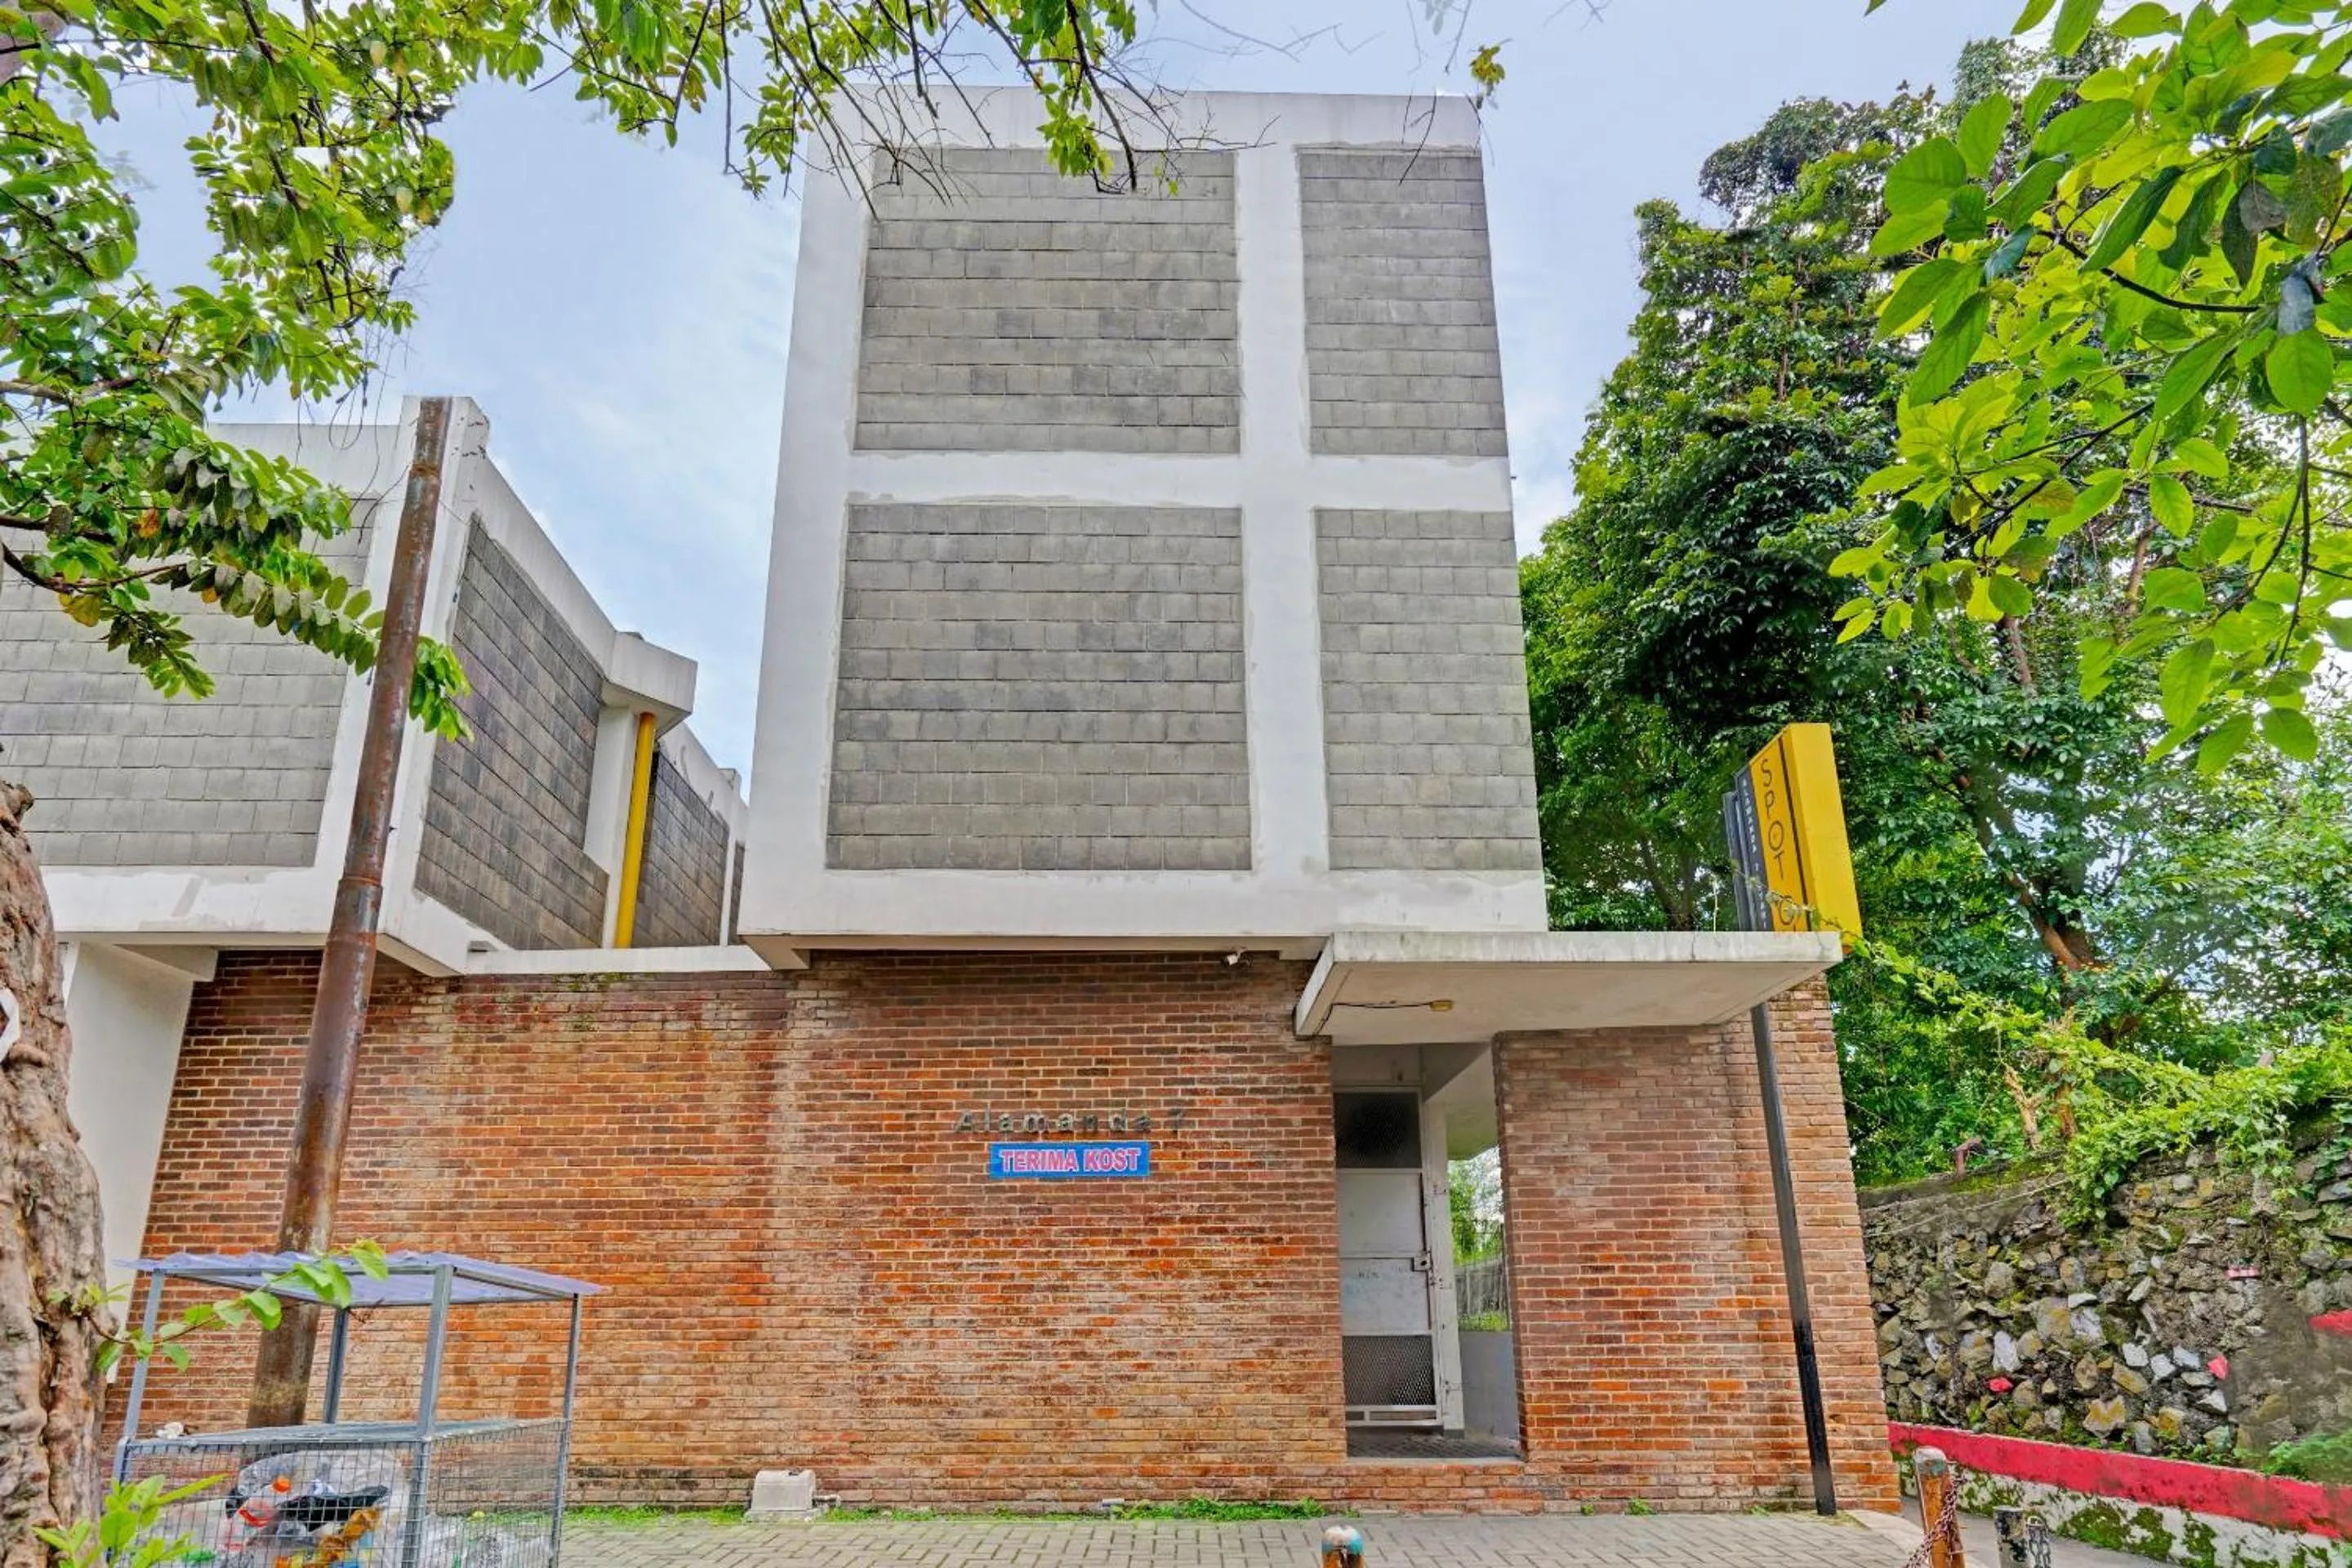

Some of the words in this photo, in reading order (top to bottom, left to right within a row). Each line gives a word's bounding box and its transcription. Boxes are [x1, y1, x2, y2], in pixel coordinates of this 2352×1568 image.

[1761, 758, 1784, 880] SPOT
[953, 1107, 1152, 1134] Alamanda
[999, 1148, 1079, 1172] TERIMA
[1084, 1147, 1141, 1171] KOST
